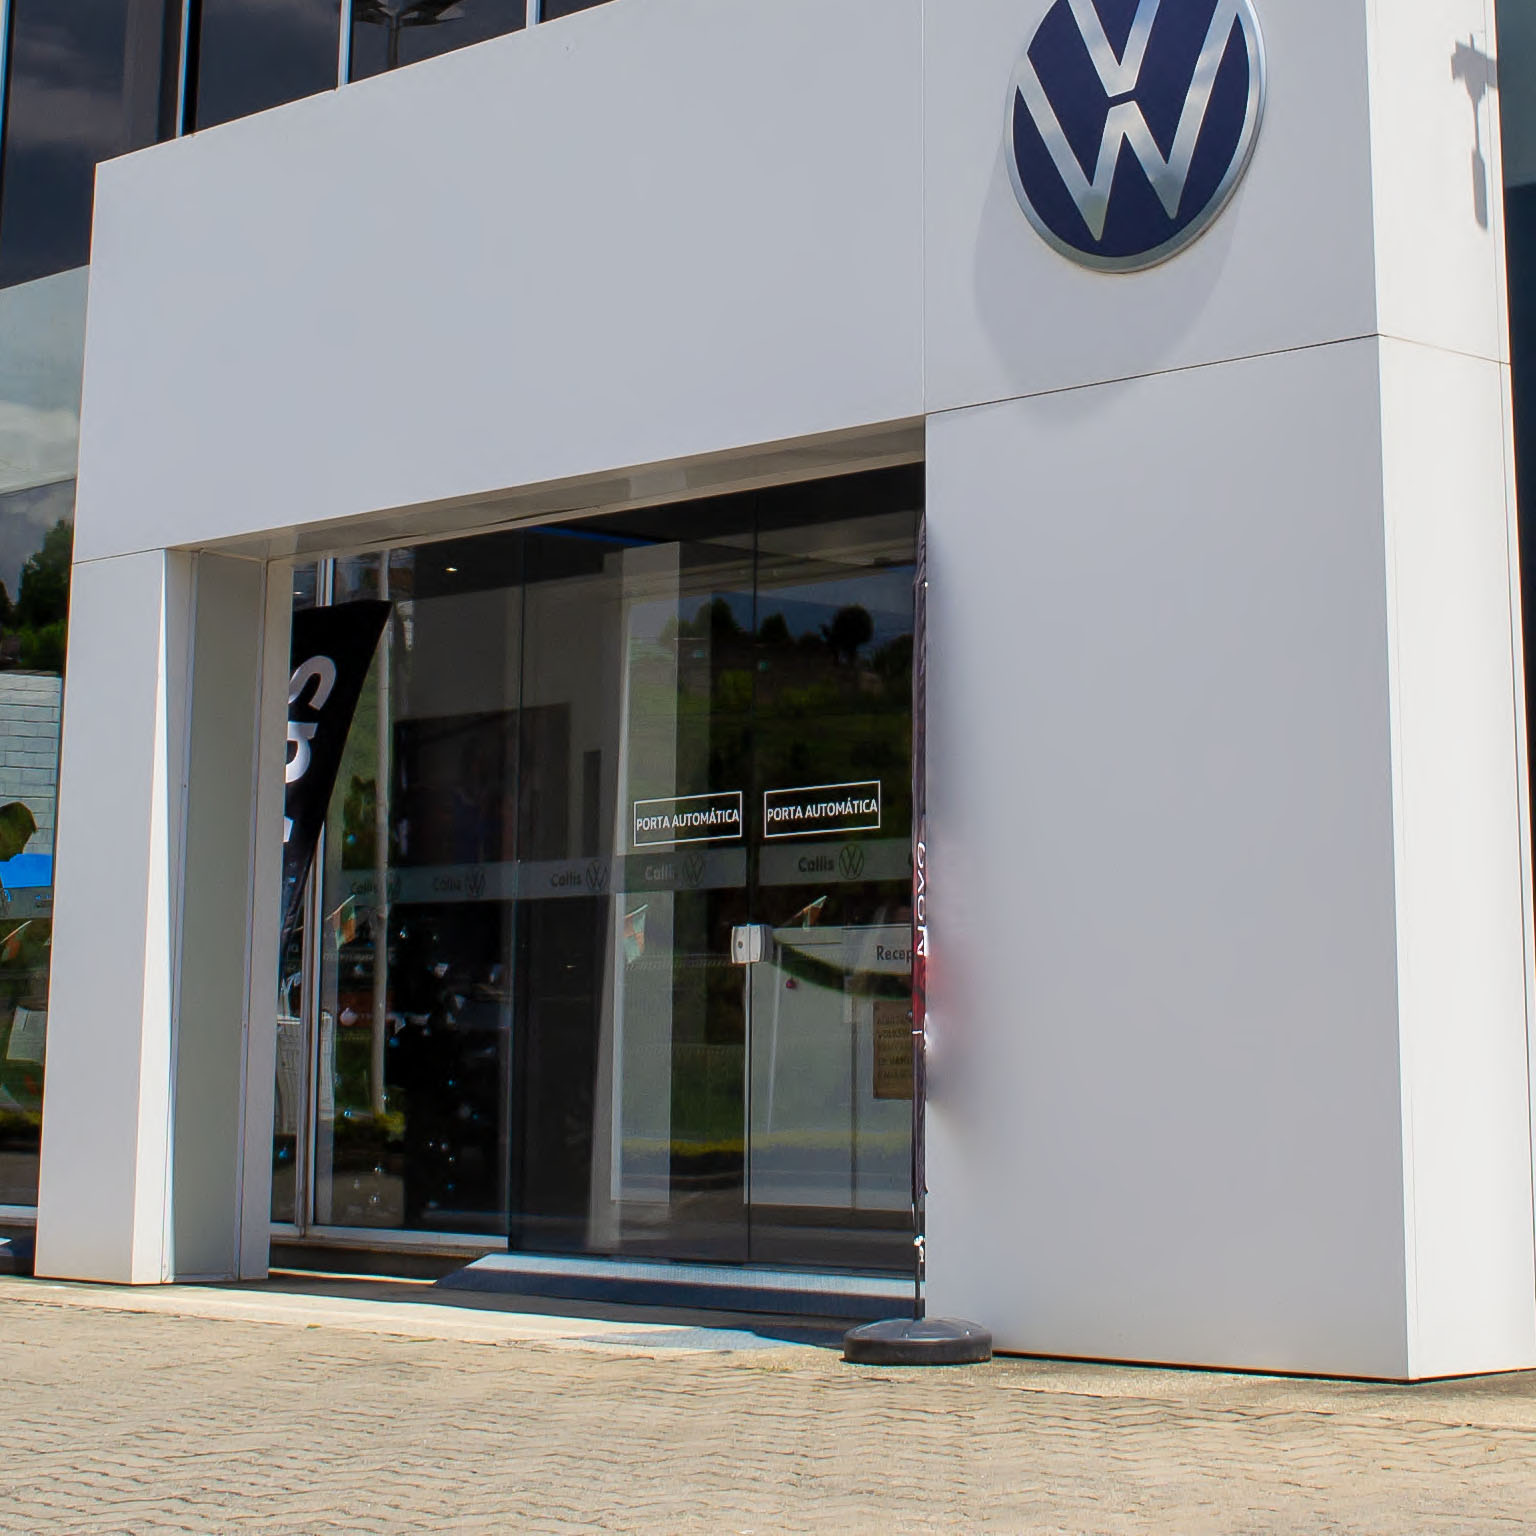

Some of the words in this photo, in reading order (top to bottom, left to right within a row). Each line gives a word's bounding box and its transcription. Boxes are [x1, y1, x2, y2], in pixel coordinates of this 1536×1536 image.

[636, 815, 670, 831] PORTA
[672, 807, 739, 827] AUTOMÁTICA
[765, 805, 803, 822] PORTA
[805, 797, 877, 818] AUTOMÁTICA
[797, 856, 835, 872] Callis
